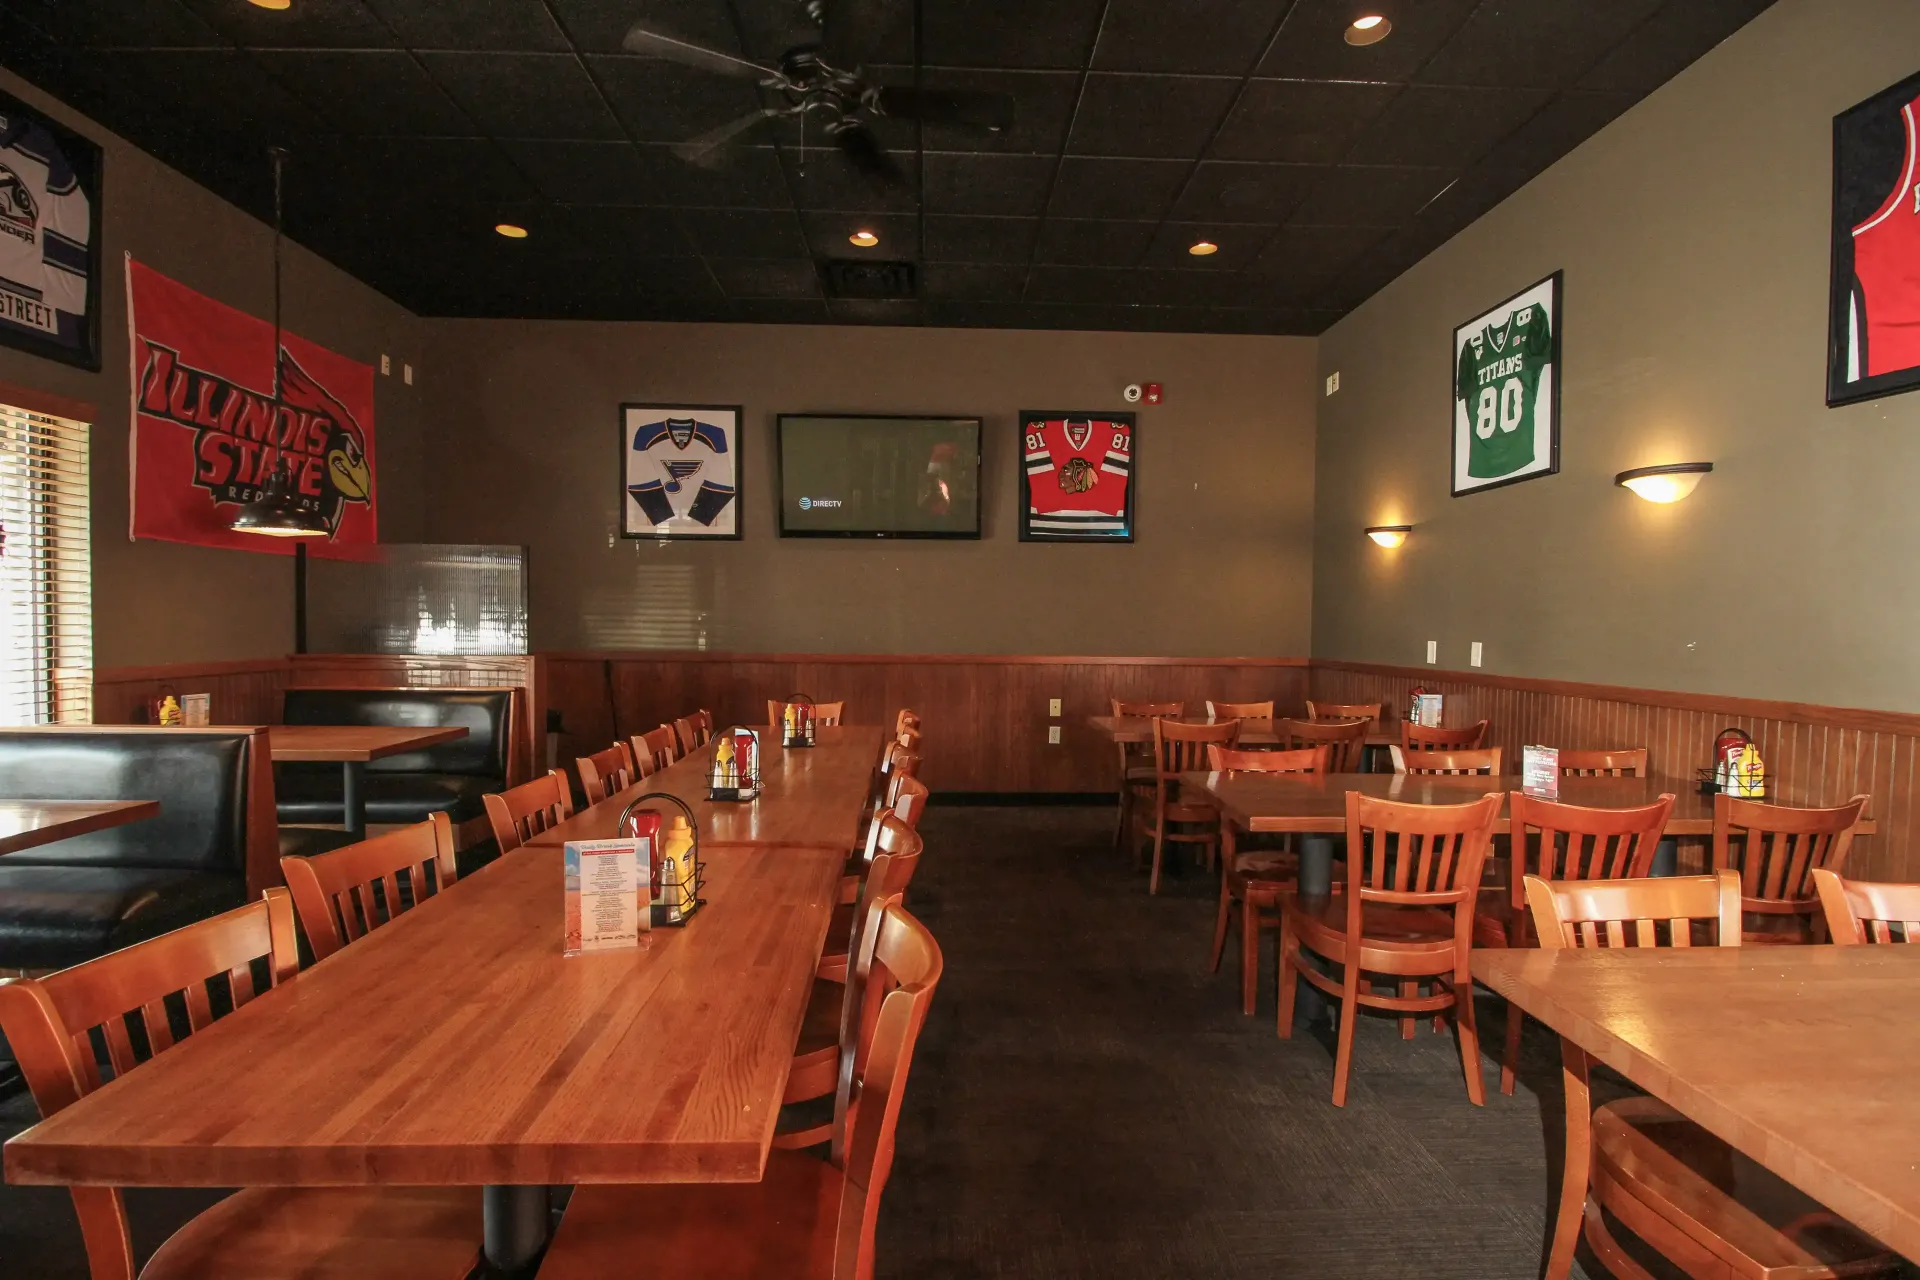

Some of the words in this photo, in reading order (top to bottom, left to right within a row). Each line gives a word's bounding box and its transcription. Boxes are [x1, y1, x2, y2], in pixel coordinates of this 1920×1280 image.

[0, 292, 52, 329] STREET
[1477, 353, 1523, 385] TITANS
[143, 349, 331, 455] ILLINOIS
[1476, 376, 1524, 440] 80
[1025, 431, 1046, 450] 81
[1111, 433, 1130, 452] 81
[198, 431, 324, 496] STATE
[228, 486, 320, 512] REDDS
[812, 500, 842, 508] DIRECTV
